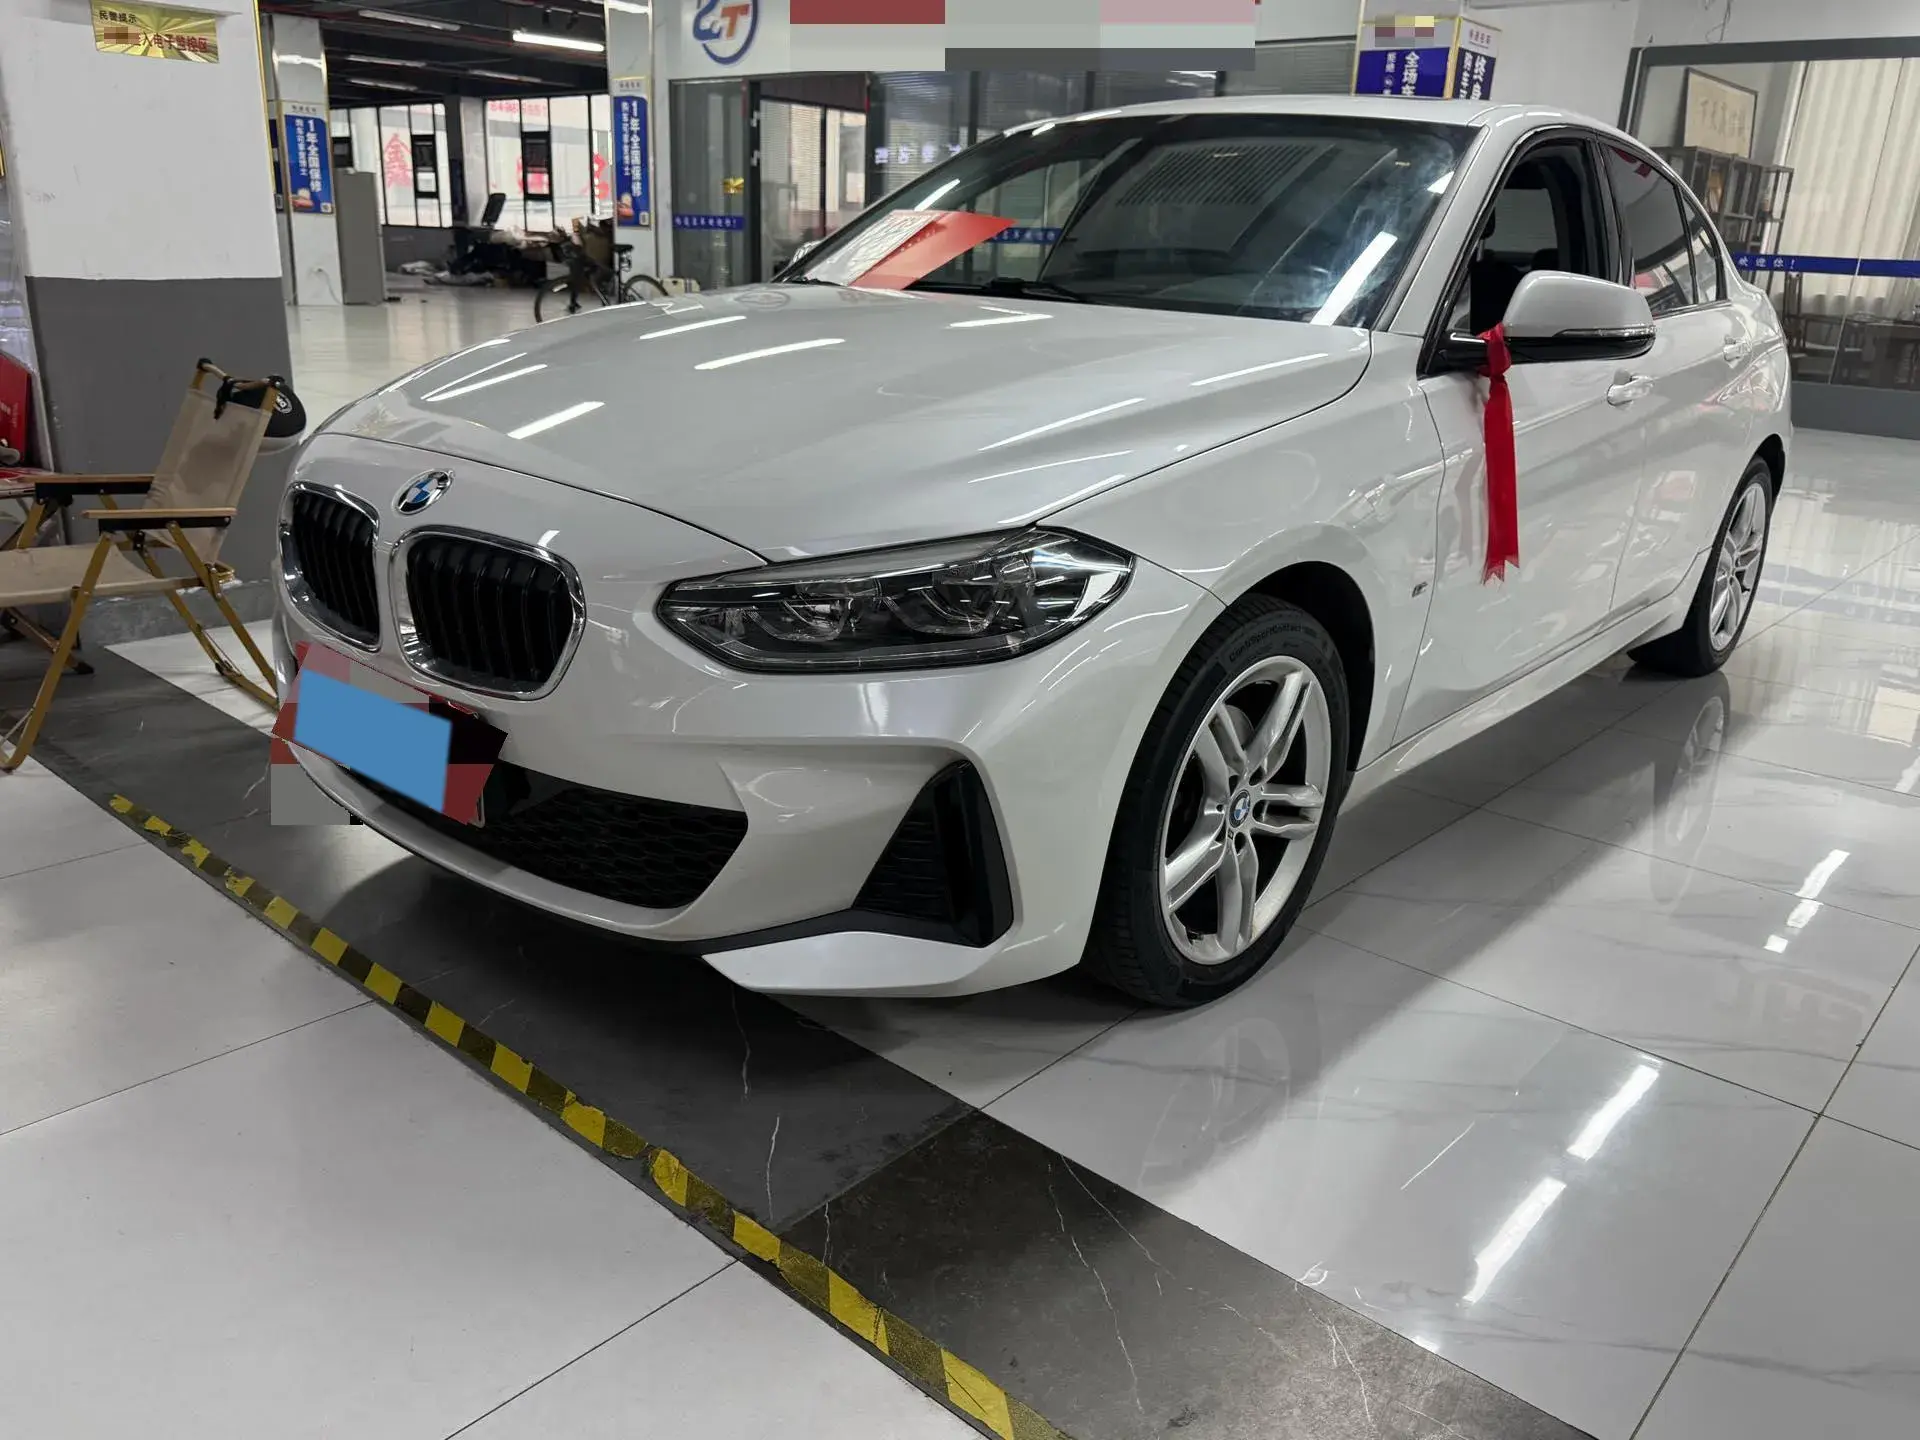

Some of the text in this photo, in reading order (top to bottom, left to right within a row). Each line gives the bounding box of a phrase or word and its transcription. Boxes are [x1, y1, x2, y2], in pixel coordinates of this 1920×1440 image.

[99, 10, 138, 24] 民警提示
[306, 119, 322, 192] 1年全国保修
[630, 101, 642, 197] 1年全国保修
